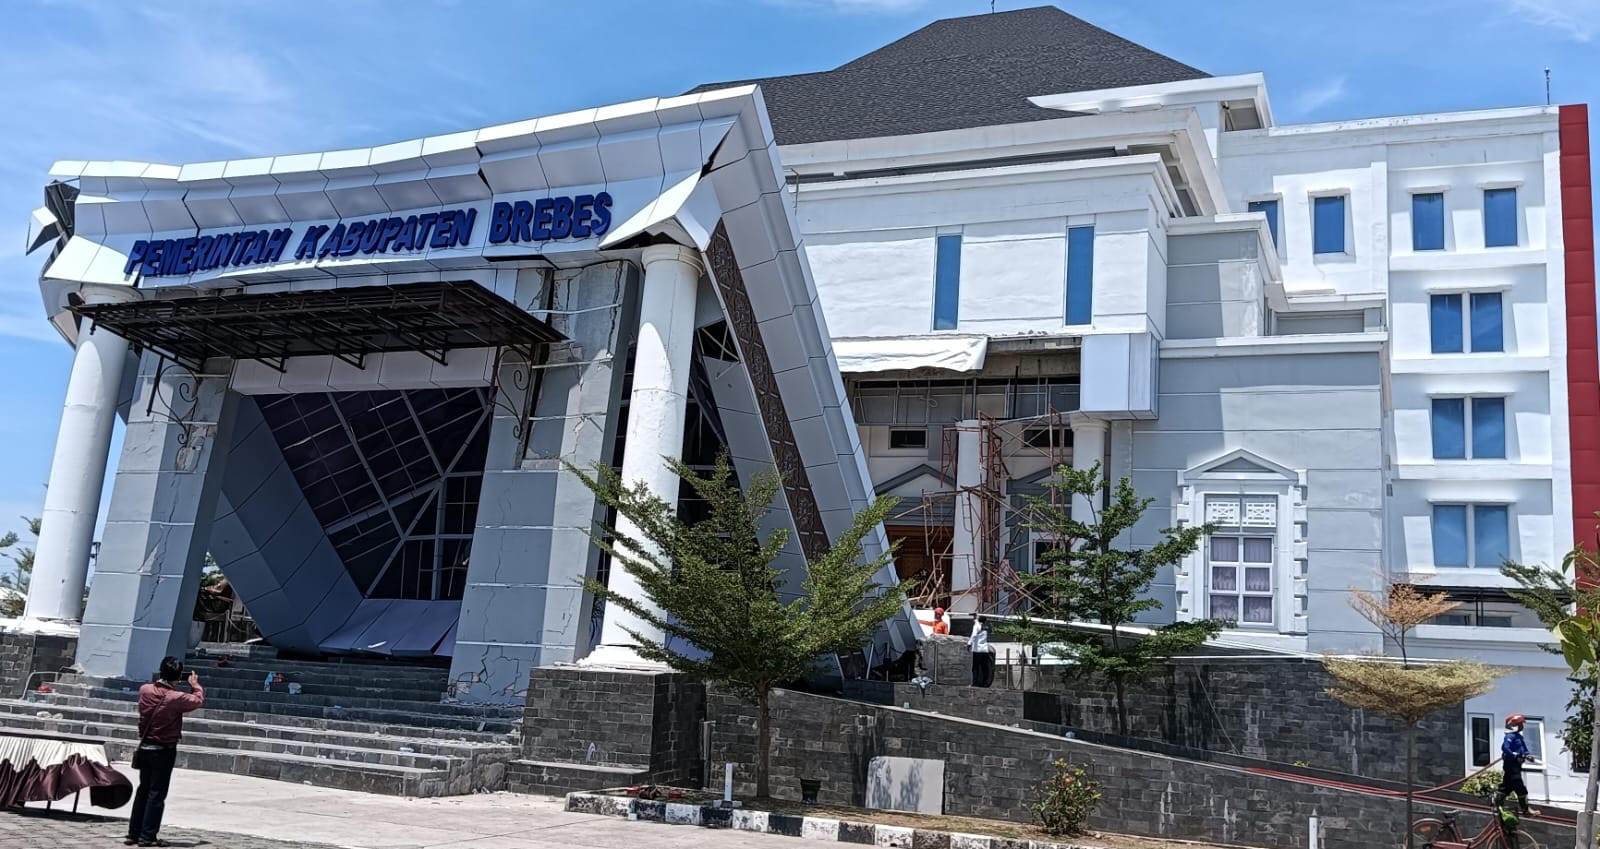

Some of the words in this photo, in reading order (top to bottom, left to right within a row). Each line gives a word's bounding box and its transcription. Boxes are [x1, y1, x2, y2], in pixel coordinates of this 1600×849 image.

[125, 228, 292, 276] PEMERINTAH
[295, 208, 477, 259] KABUPATEN
[489, 193, 612, 244] BREBES
